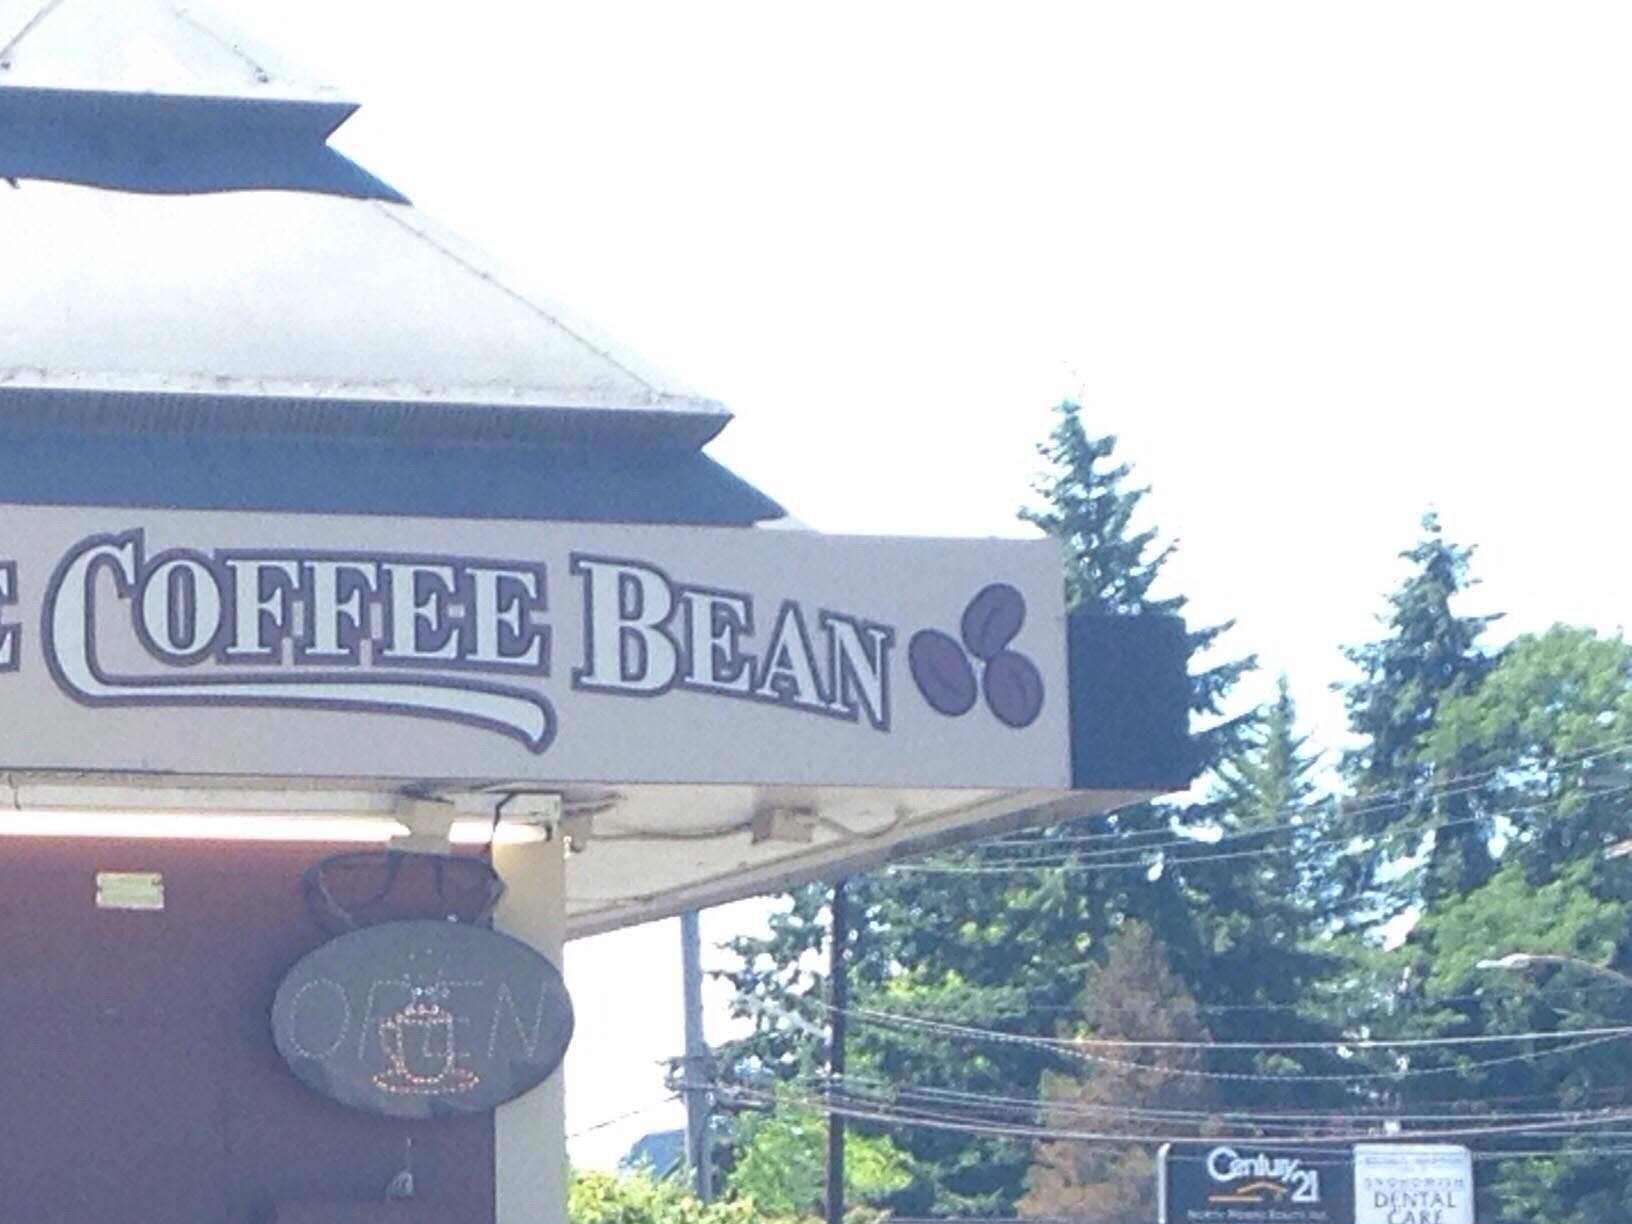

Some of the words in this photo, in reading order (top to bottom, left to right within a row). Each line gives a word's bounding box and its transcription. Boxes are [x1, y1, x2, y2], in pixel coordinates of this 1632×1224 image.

[41, 528, 555, 755] COFFEE
[570, 551, 893, 732] BEAN
[1207, 1145, 1301, 1182] Century
[1291, 1169, 1320, 1203] 21
[1374, 1190, 1458, 1209] DENTAL
